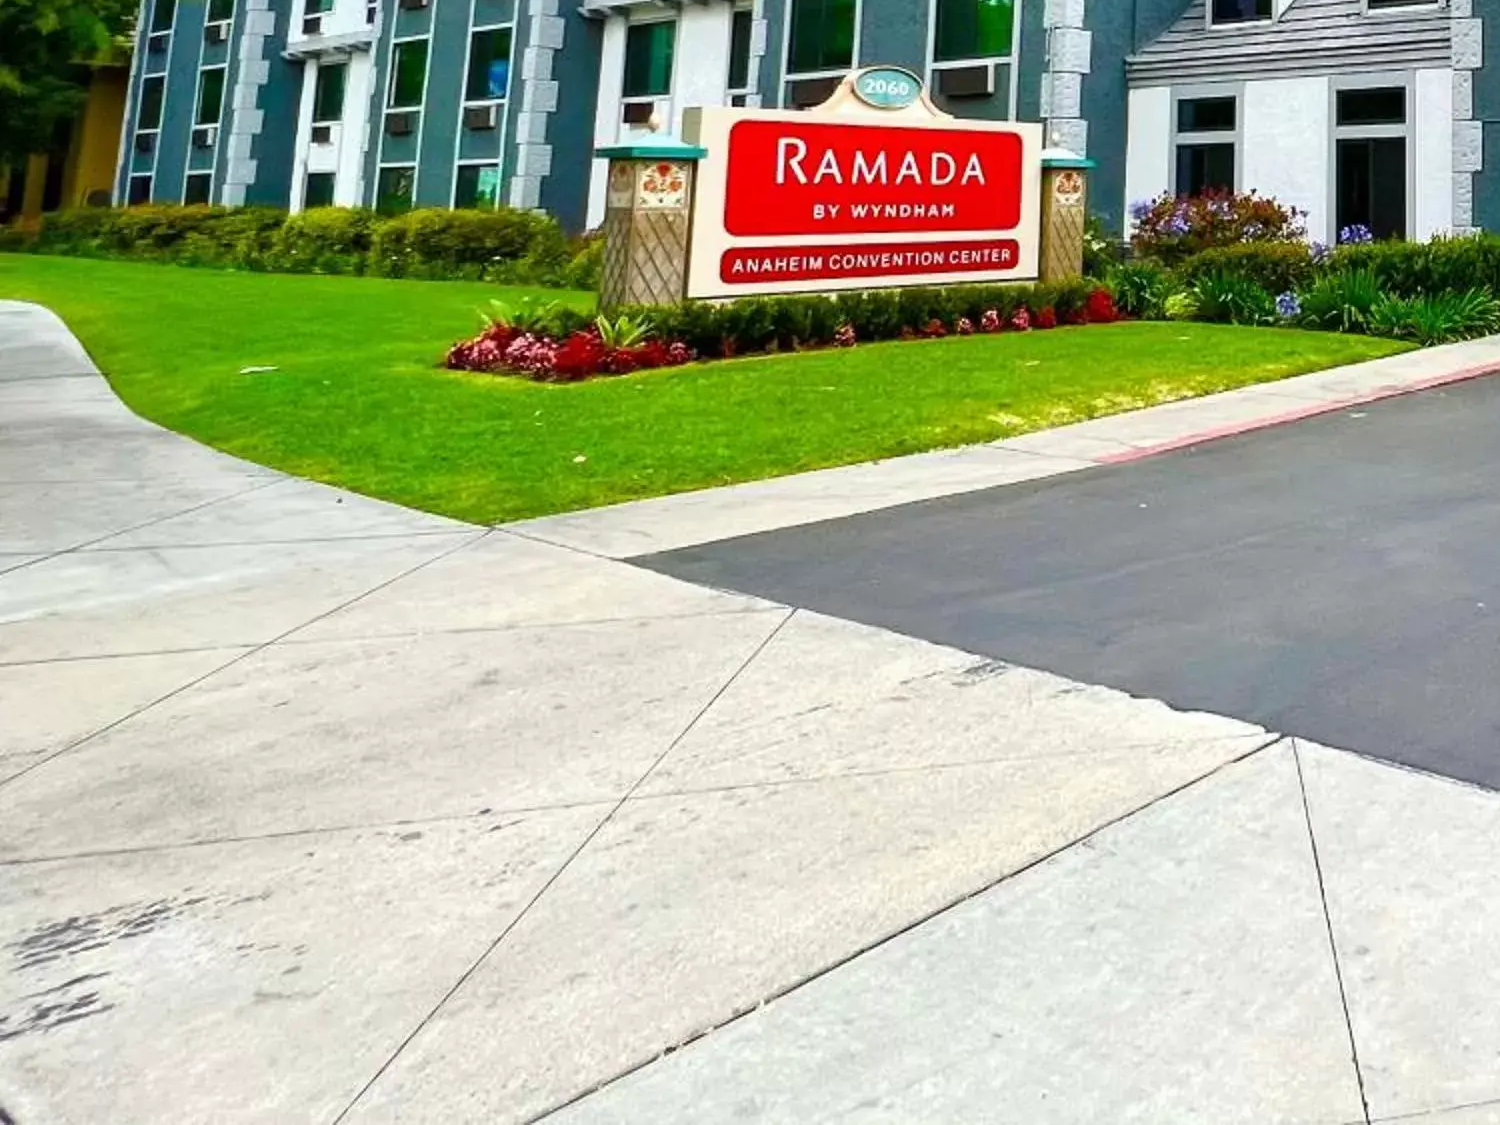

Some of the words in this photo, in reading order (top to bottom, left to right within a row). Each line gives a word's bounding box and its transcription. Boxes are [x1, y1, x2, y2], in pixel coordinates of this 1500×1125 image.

[864, 78, 909, 96] 2060
[775, 137, 986, 186] RAMADA
[813, 203, 840, 220] BY
[851, 203, 955, 219] WYNDHAM
[731, 256, 823, 274] ANAHEIM
[828, 250, 945, 270] CONVENTION
[949, 248, 1011, 265] CENTER
